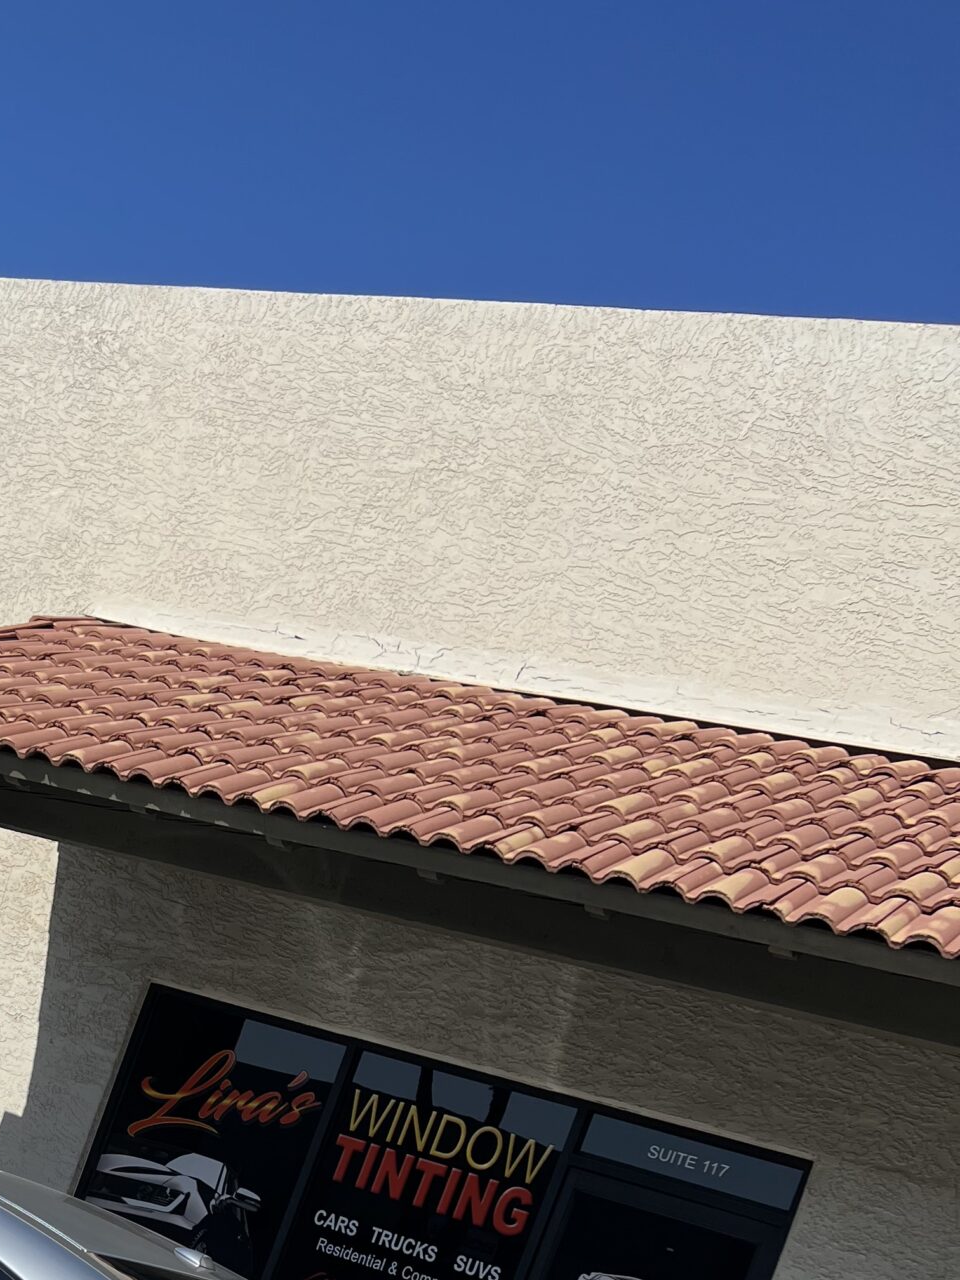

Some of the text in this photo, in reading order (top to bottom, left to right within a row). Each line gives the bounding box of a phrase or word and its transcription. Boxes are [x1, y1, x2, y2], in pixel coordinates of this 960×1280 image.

[127, 1050, 322, 1137] Lina's
[348, 1088, 555, 1184] WINDOW
[647, 1145, 730, 1177] SUITE 117
[332, 1133, 534, 1236] TINTING
[314, 1209, 359, 1237] CARS
[370, 1226, 438, 1262] TRUCKS
[316, 1237, 387, 1272] Residential
[388, 1261, 398, 1276] &
